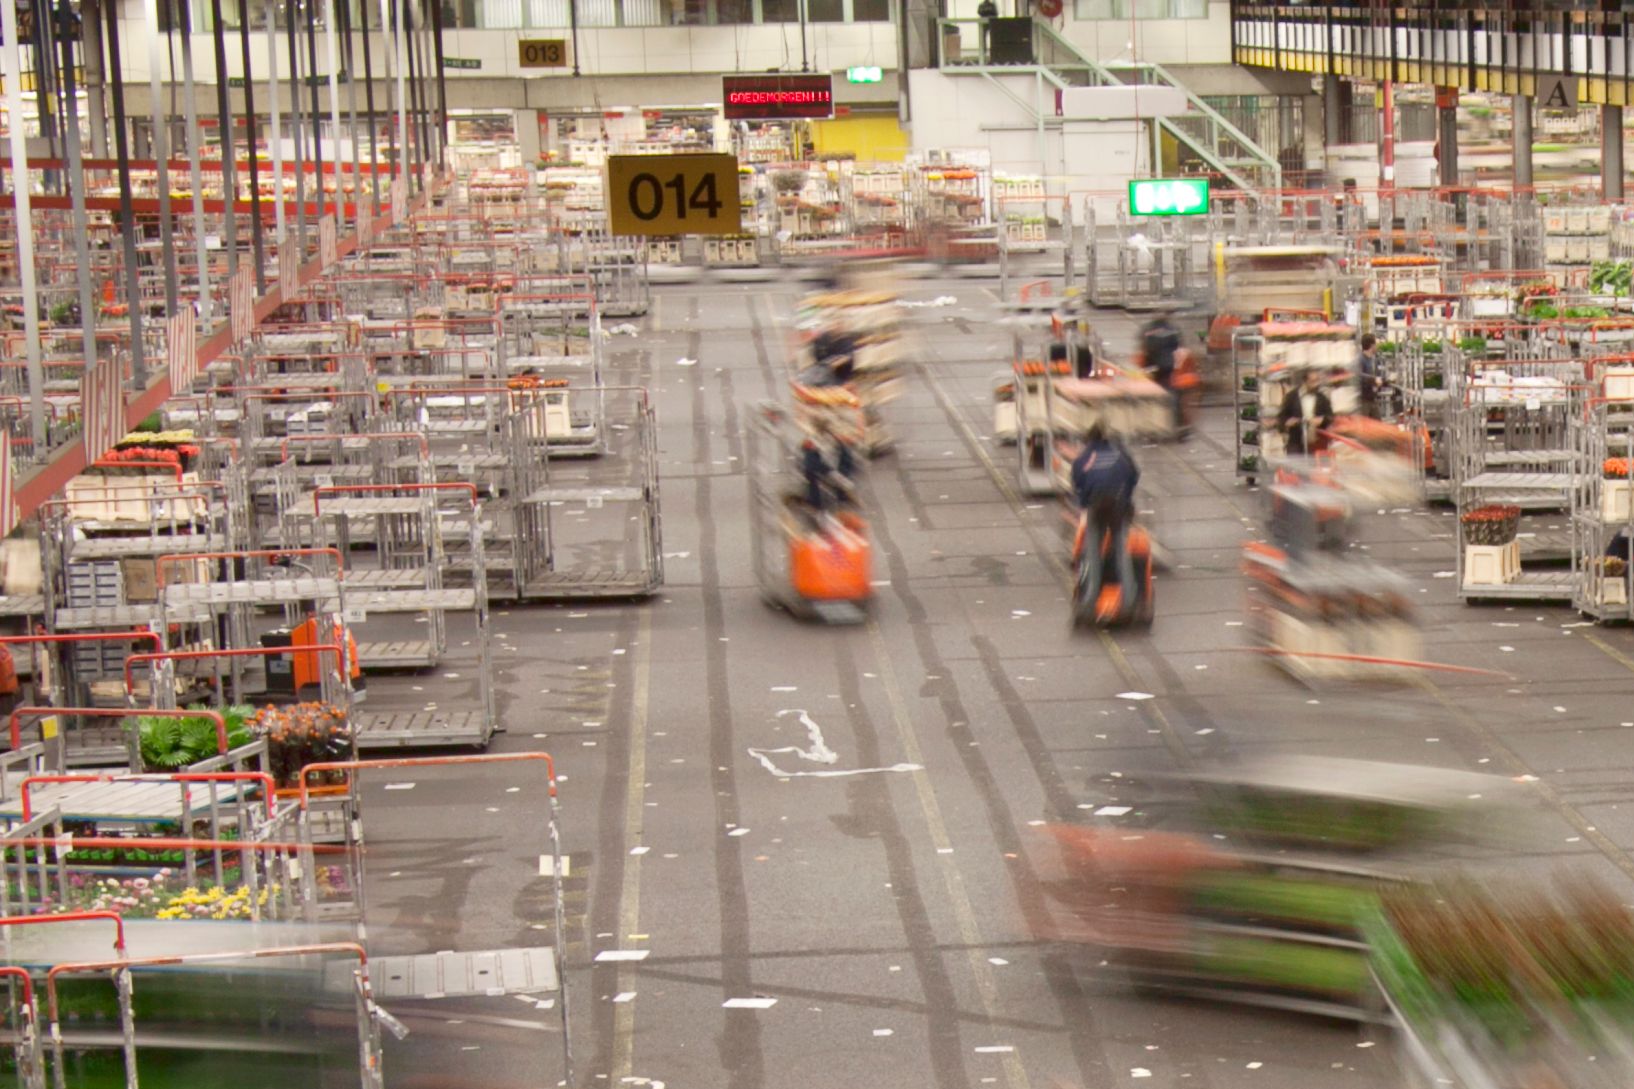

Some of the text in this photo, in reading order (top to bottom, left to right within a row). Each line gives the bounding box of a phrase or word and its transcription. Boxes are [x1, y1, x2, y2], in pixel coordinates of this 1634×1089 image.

[525, 44, 559, 62] 013
[1544, 80, 1570, 107] A
[629, 173, 722, 221] 014
